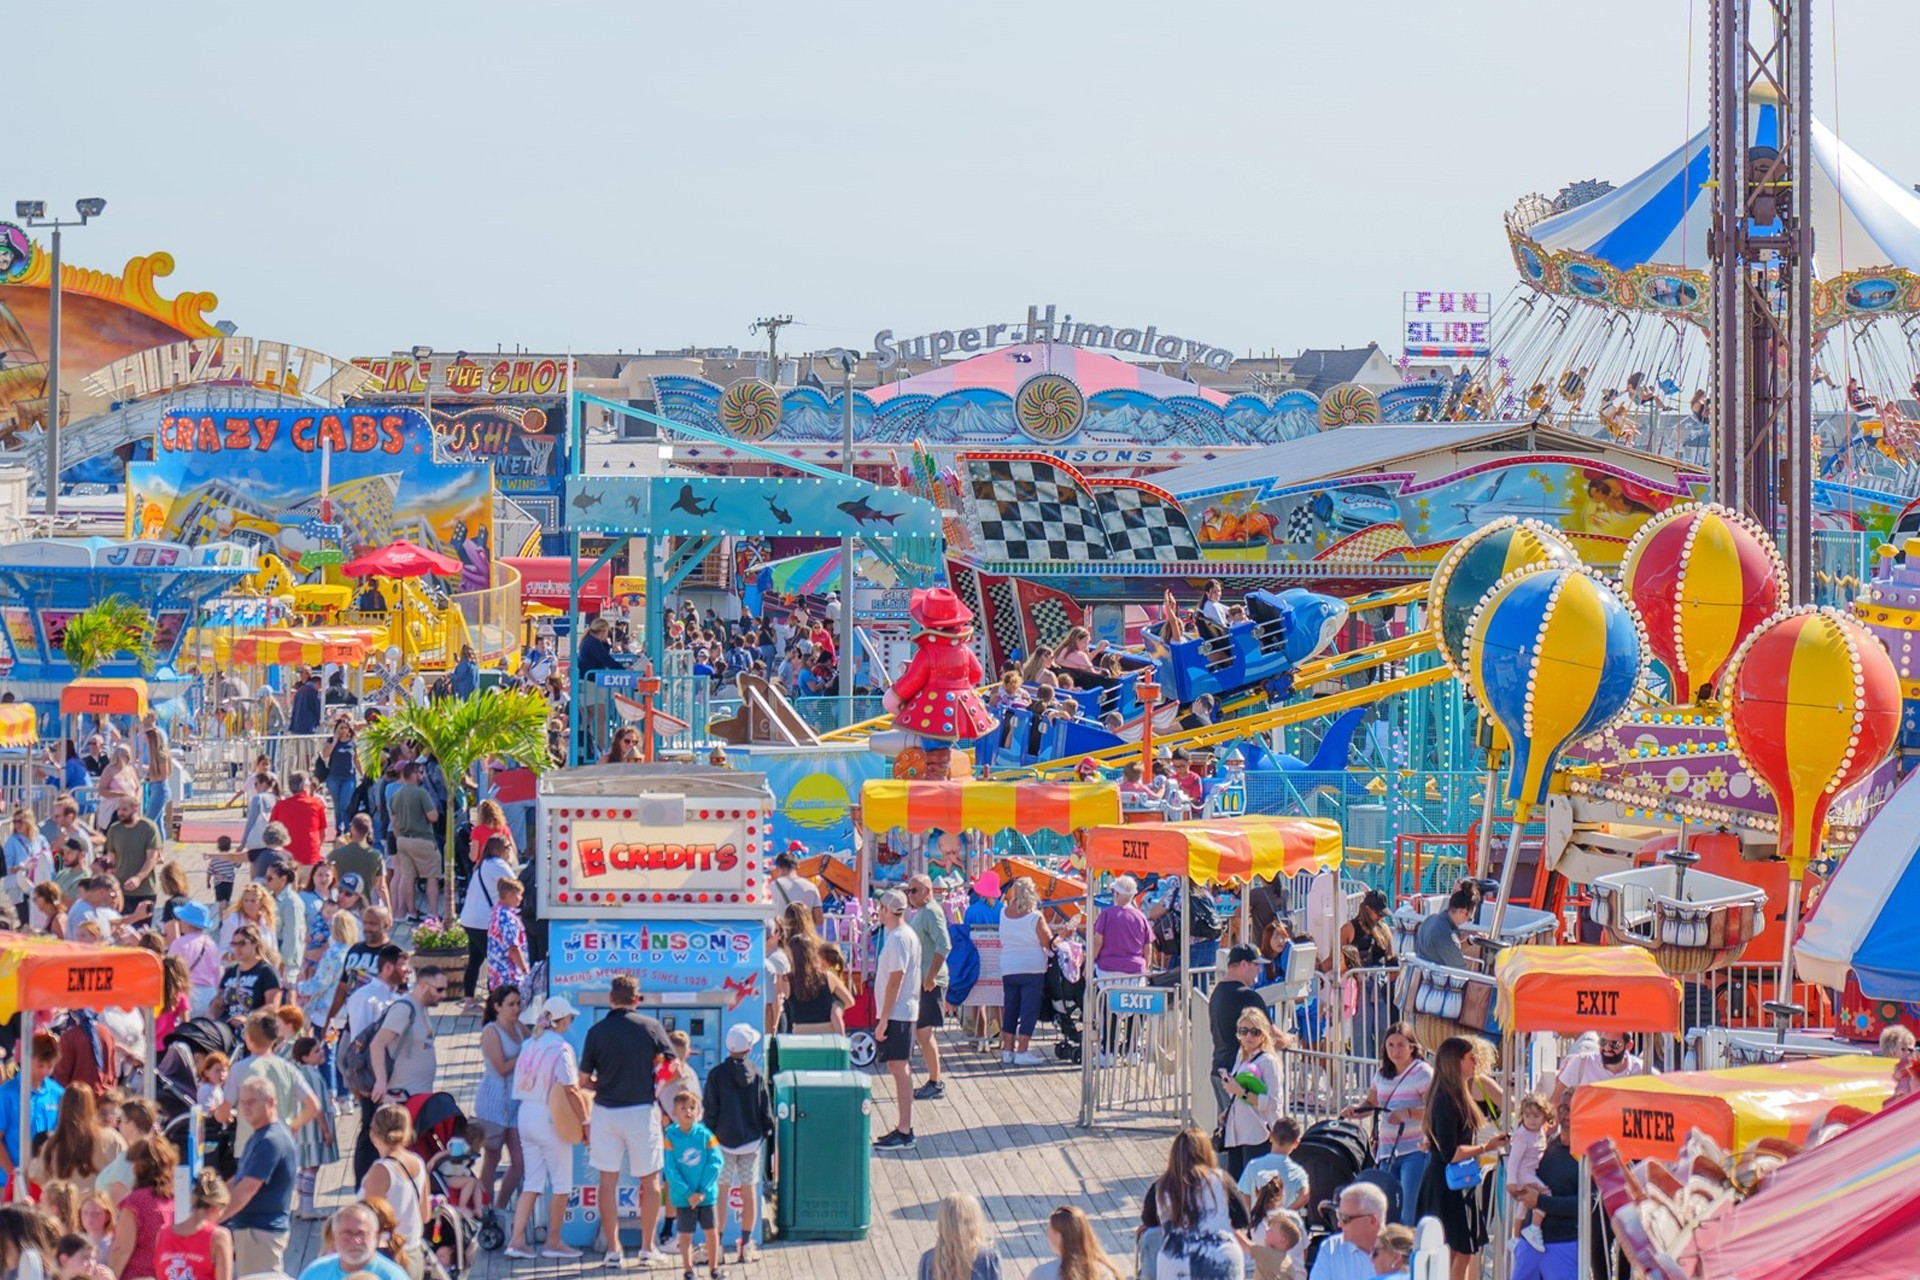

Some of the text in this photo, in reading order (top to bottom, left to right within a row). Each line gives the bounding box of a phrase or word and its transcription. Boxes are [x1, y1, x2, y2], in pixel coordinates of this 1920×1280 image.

[1416, 292, 1477, 312] FUN
[1408, 322, 1485, 342] SLIDE
[446, 366, 484, 389] THE
[487, 360, 577, 395] SHOT
[160, 415, 406, 455] CRAZY CABS
[507, 480, 536, 490] WINS
[603, 675, 632, 687] EXIT
[89, 693, 110, 707] EXIT
[609, 842, 739, 872] CREDITS
[1122, 840, 1150, 860] EXIT
[564, 952, 750, 963] BOARDWALK
[67, 966, 114, 992] ENTER
[554, 967, 709, 987] MAKING MEMORIES SINCE 1928
[1119, 993, 1154, 1010] EXIT
[1577, 990, 1619, 1016] EXIT
[1622, 1107, 1675, 1143] ENTER
